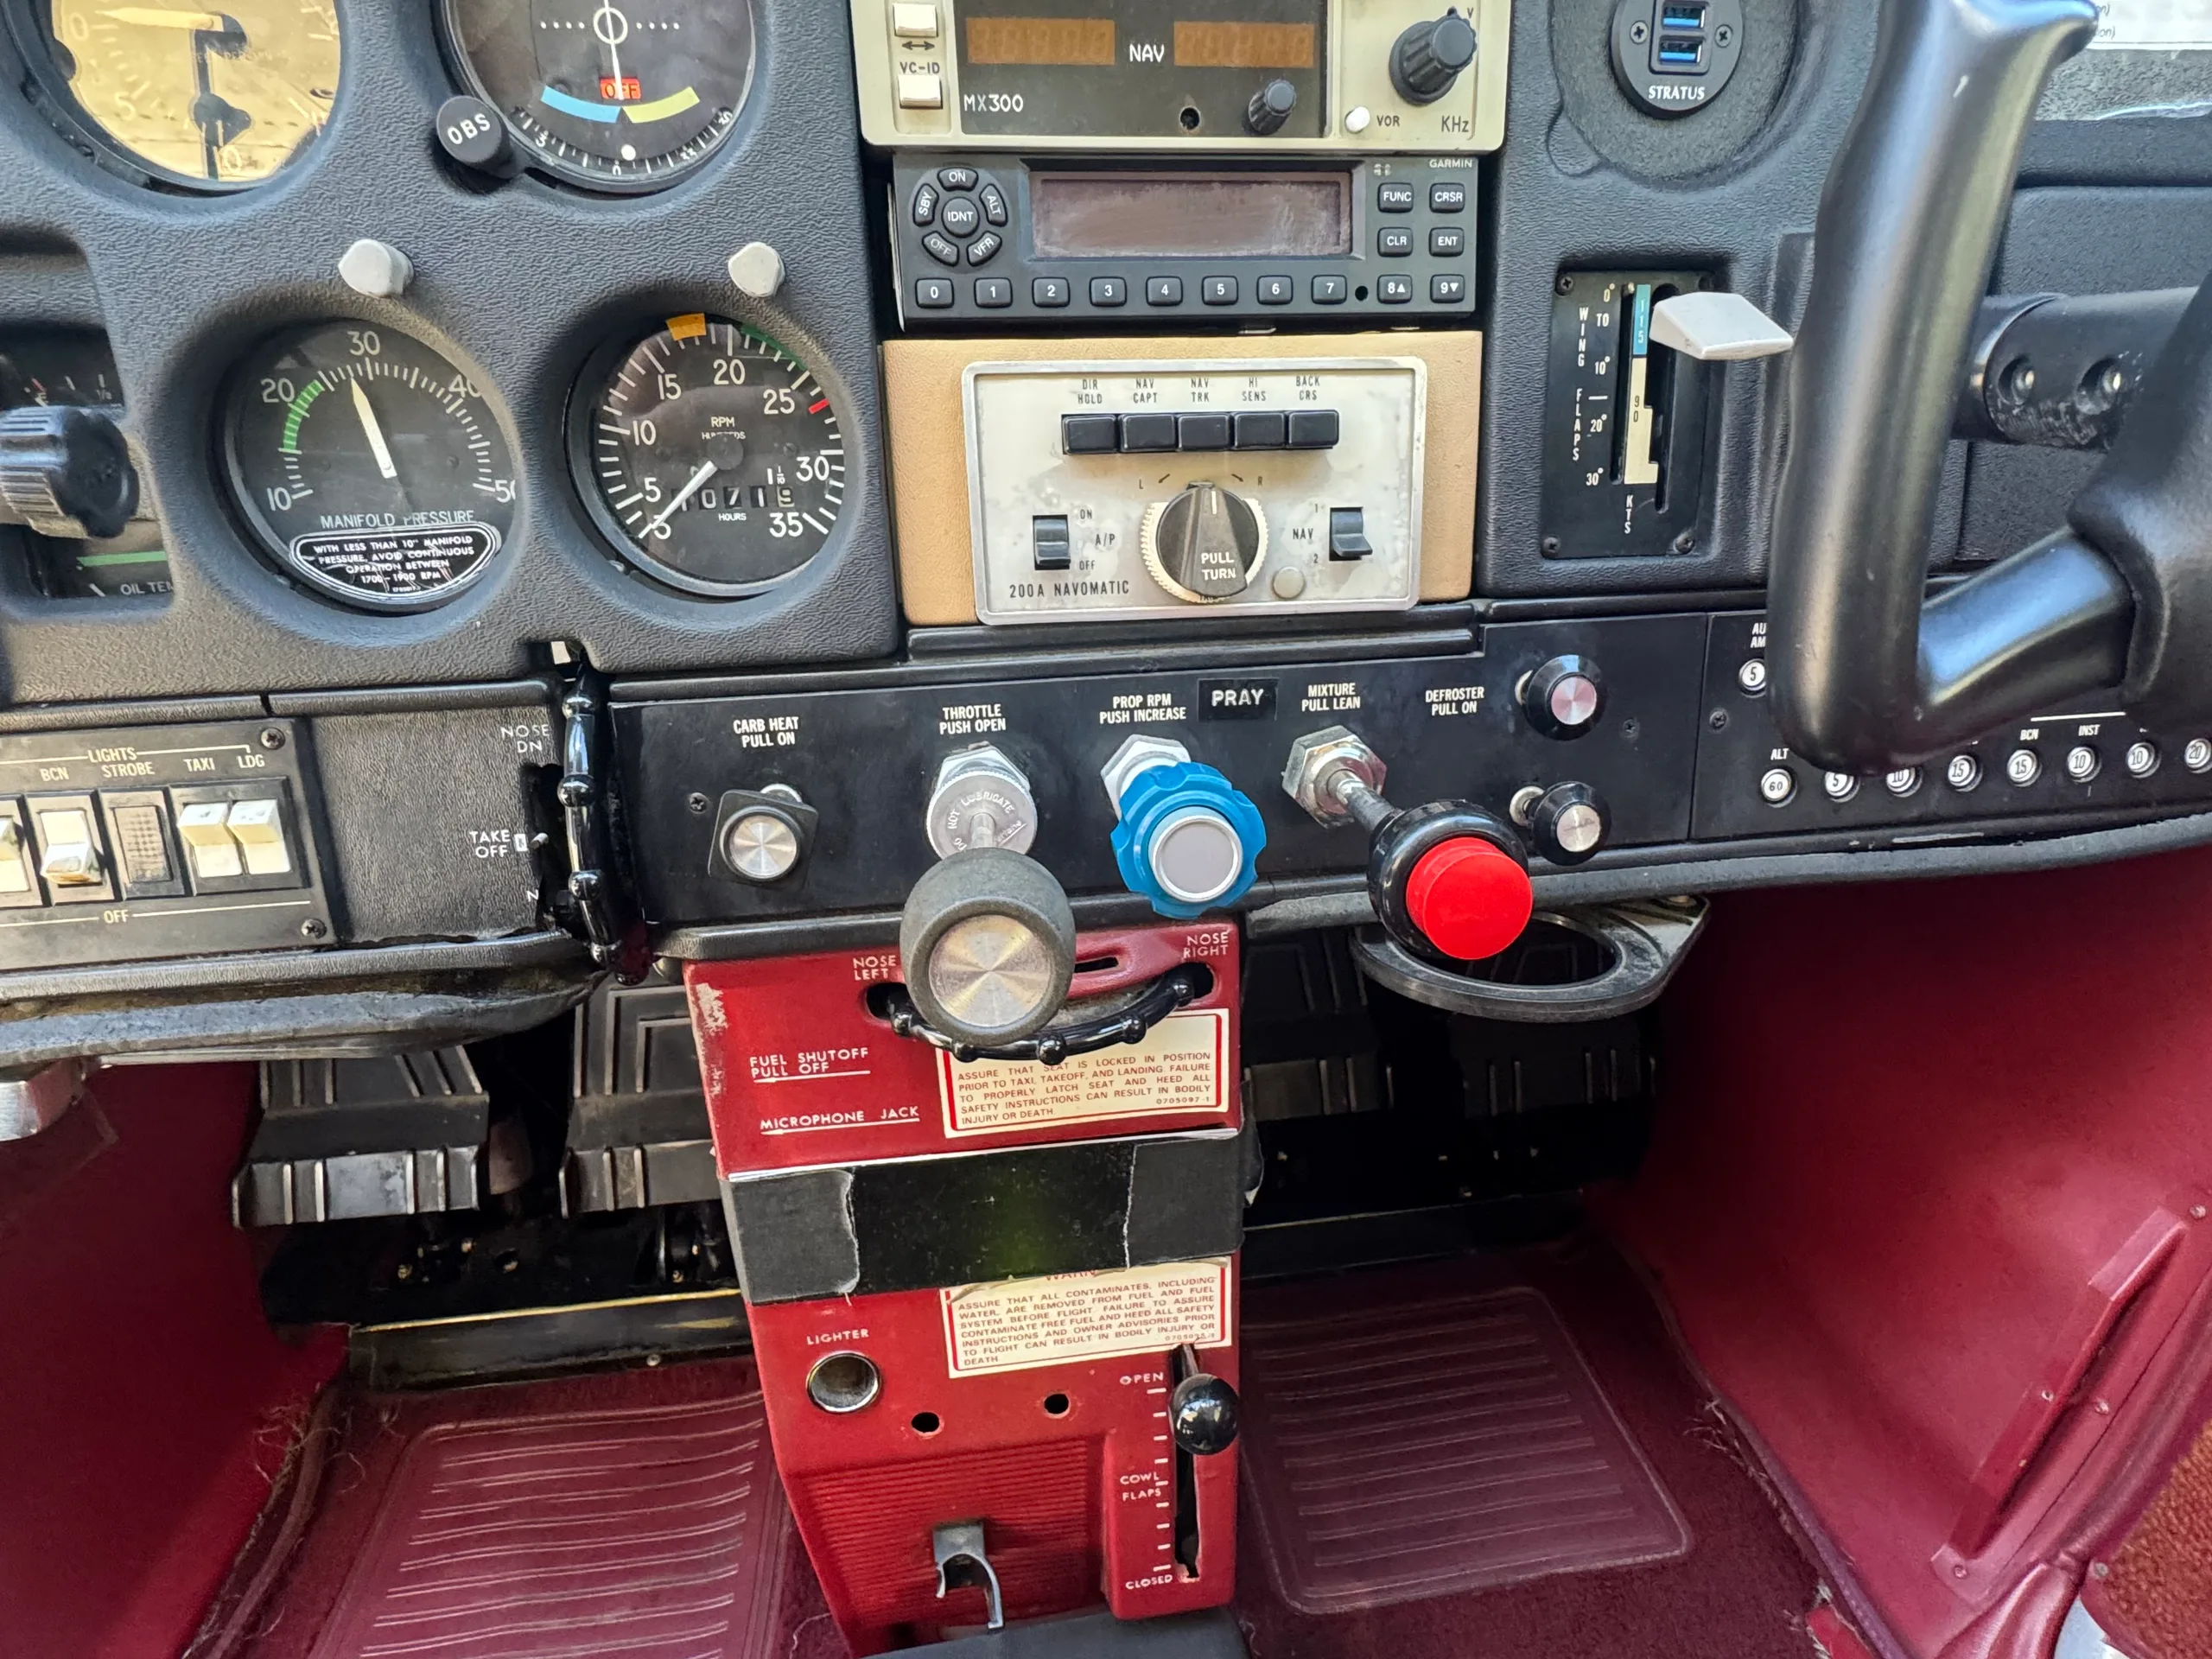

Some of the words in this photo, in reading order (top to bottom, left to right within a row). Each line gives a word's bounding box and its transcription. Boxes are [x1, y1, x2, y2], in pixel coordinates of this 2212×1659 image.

[1128, 44, 1165, 62] NAV
[899, 61, 940, 74] VC-ID
[1648, 85, 1706, 100] STRATUS
[963, 93, 1024, 112] MX300
[447, 112, 491, 145] OBS
[1376, 115, 1401, 127] VOR
[1441, 115, 1470, 133] KHz
[1429, 159, 1472, 168] GARMIN
[949, 171, 966, 182] ON
[918, 191, 932, 216] SBY
[1383, 192, 1412, 201] FUNC
[1434, 192, 1463, 202] CRSR
[986, 194, 1001, 216] ALT
[947, 212, 974, 222] IDNT
[930, 238, 951, 257] OFF
[974, 237, 995, 257] VFR
[1387, 236, 1408, 246] CLR
[1438, 236, 1458, 246] ENT
[930, 287, 938, 298] 0
[990, 286, 996, 297] 1
[1047, 285, 1056, 296] 2
[1104, 284, 1113, 296] 3
[1160, 284, 1169, 296] 4
[1217, 283, 1225, 296] 5
[1272, 283, 1281, 295] 6
[1326, 283, 1334, 295] 7
[1596, 312, 1610, 327] TO
[347, 330, 380, 356] 30
[1578, 307, 1589, 367] WING
[713, 359, 746, 385] 20
[658, 373, 682, 400] 15
[1083, 378, 1098, 390] DIR
[1135, 378, 1154, 389] NAV
[1191, 378, 1209, 388] NAV
[1249, 377, 1258, 387] HI
[1296, 375, 1320, 387] BACK
[261, 378, 295, 404] 20
[1077, 393, 1103, 404] HOLD
[1133, 392, 1158, 404] CAPT
[1191, 391, 1210, 403] TRK
[1242, 391, 1267, 402] SENS
[1299, 390, 1318, 401] CRS
[763, 389, 795, 415] 25
[710, 416, 735, 428] RPM
[1573, 388, 1583, 461] FLAPS
[632, 419, 657, 445] 10
[796, 455, 828, 482] 30
[1139, 479, 1144, 490] L
[1258, 476, 1263, 486] R
[644, 477, 661, 503] 5
[267, 487, 292, 511] 10
[321, 513, 396, 529] MANIFOLD
[718, 512, 747, 521] HOURS
[1080, 509, 1093, 519] ON
[1624, 493, 1634, 534] KTS
[769, 512, 804, 537] 35
[1095, 532, 1116, 546] A/P
[1292, 528, 1313, 540] NAV
[313, 544, 340, 554] WITH
[344, 543, 366, 552] LESS
[371, 541, 397, 550] THAN
[423, 535, 474, 546] MANIFOLD
[372, 551, 403, 562] AVOID
[407, 547, 474, 559] CONTINUOUS
[1201, 552, 1235, 564] PULL
[1313, 553, 1319, 563] 2
[346, 563, 402, 575] OPERATION
[405, 560, 449, 570] BETWEEN
[1078, 560, 1096, 570] OFF
[420, 570, 442, 581] RPM
[1202, 568, 1236, 581] TURN
[120, 583, 145, 595] OIL
[1009, 583, 1045, 598] 200A
[1054, 580, 1129, 596] NAVOMATIC
[1750, 666, 1757, 682] 5
[1307, 683, 1356, 697] MIXTURE
[1425, 686, 1484, 703] DEFROSTER
[1113, 695, 1144, 709] PROP
[1147, 693, 1172, 707] RPM
[1211, 689, 1264, 707] PRAY
[1301, 696, 1329, 712] PULL
[1332, 695, 1361, 710] LEAN
[943, 704, 1002, 720] THROTTLE
[1099, 709, 1130, 724] PUSH
[1134, 707, 1186, 722] INCREASE
[1431, 701, 1459, 717] PULL
[1462, 701, 1478, 715] ON
[501, 724, 550, 739] NOSE
[733, 719, 766, 734] CARB
[769, 716, 799, 732] HEAT
[939, 720, 971, 734] PUSH
[974, 718, 1006, 733] OPEN
[2078, 724, 2101, 736] INST
[741, 733, 774, 748] PULL
[778, 731, 795, 746] ON
[2019, 728, 2039, 741] BCN
[517, 739, 543, 753] DN
[2189, 744, 2202, 760] 20
[87, 747, 137, 763] LIGHTS
[236, 754, 265, 768] LDG
[1770, 748, 1789, 760] ALT
[2075, 754, 2086, 769] 10
[2132, 750, 2143, 766] 10
[101, 761, 155, 779] STROBE
[183, 757, 215, 772] TAXI
[1952, 763, 1965, 777] 15
[2015, 759, 2027, 775] 15
[40, 767, 69, 782] BCN
[1769, 781, 1783, 791] 60
[469, 829, 511, 843] TAKE
[475, 843, 508, 859] OFF
[103, 908, 129, 925] OFF
[1186, 931, 1229, 945] NOSE
[1183, 944, 1228, 959] RIGHT
[853, 955, 897, 969] NOSE
[854, 968, 888, 981] LEFT
[749, 1053, 787, 1068] FUEL
[798, 1047, 868, 1064] SHUTOFF
[750, 1065, 789, 1079] PULL
[798, 1061, 830, 1074] OFF
[958, 1070, 999, 1081] ASSURE
[1008, 1066, 1033, 1076] THAT
[1096, 1057, 1136, 1067] LOCKED
[1163, 1052, 1211, 1062] POSITION
[959, 1082, 988, 1091] PRIOR
[994, 1079, 1007, 1089] TO
[1118, 1065, 1163, 1076] LANDING
[1170, 1063, 1211, 1072] FAILURE
[760, 1110, 865, 1130] MICROPHONE
[880, 1106, 919, 1120] JACK
[962, 1114, 999, 1124] INJURY
[1002, 1112, 1016, 1121] OR
[958, 1300, 1001, 1310] ASSURE
[1007, 1295, 1033, 1305] THAT
[1158, 1276, 1215, 1288] INCLUDING
[806, 1328, 869, 1345] LIGHTER
[1119, 1372, 1164, 1385] OPEN
[1119, 1472, 1160, 1485] COWL
[1122, 1487, 1161, 1502] FLAPS
[1124, 1573, 1173, 1590] CLOSED
